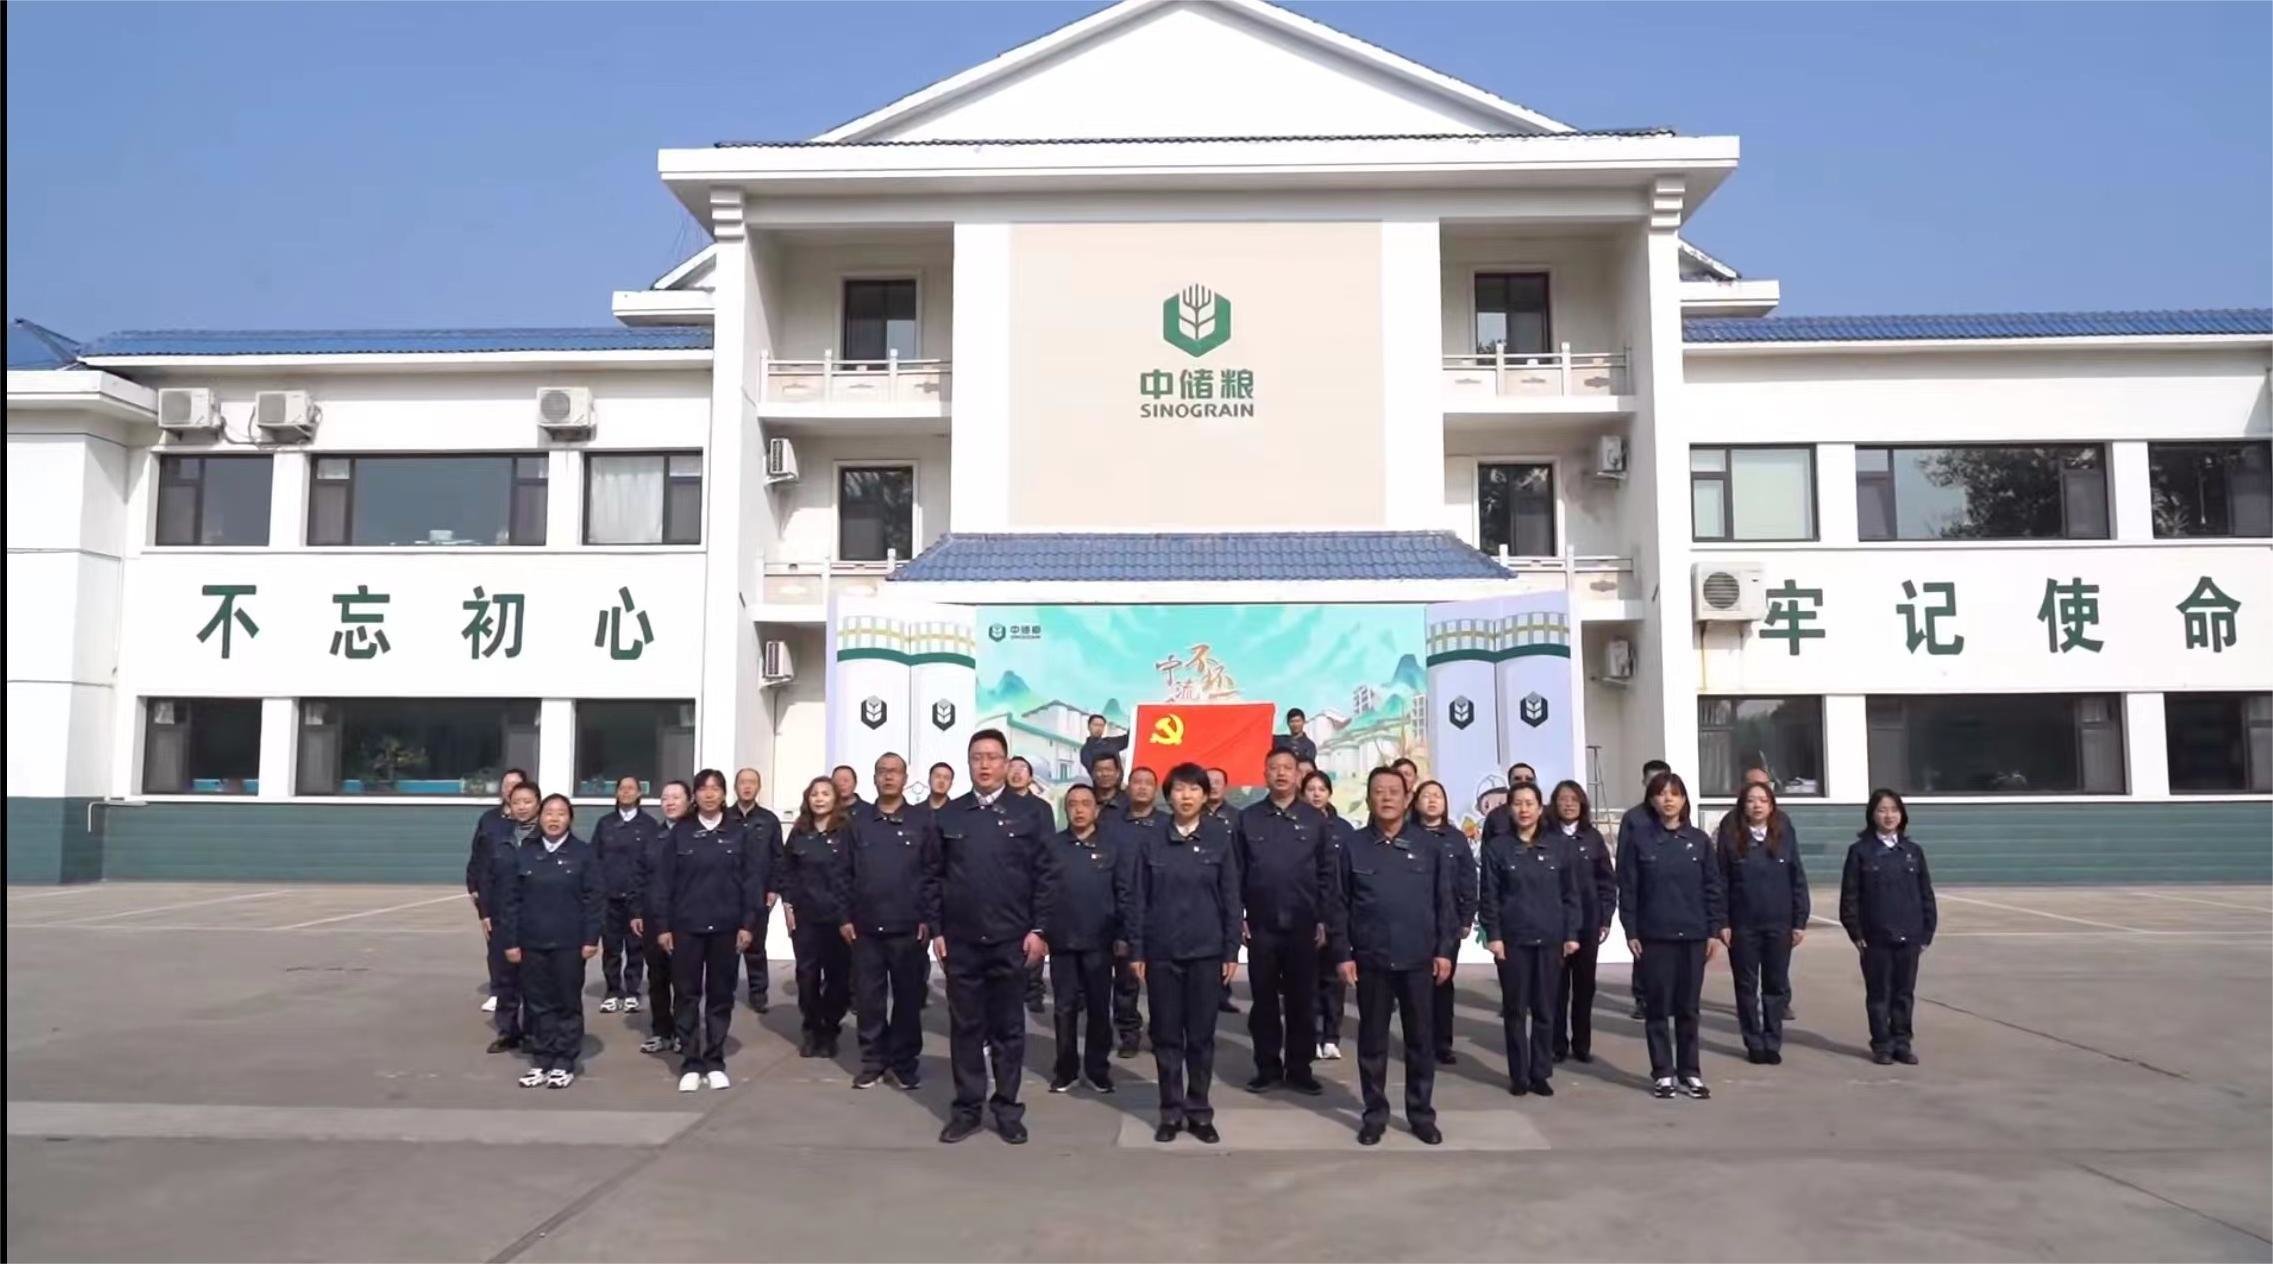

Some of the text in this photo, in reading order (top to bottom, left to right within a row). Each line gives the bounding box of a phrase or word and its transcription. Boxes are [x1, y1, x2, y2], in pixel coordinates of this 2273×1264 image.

[1140, 369, 1254, 400] 中储粮
[1140, 403, 1254, 418] SINOGRAIN
[197, 585, 655, 660] 不忘初心
[1759, 576, 2242, 656] 牢记使命
